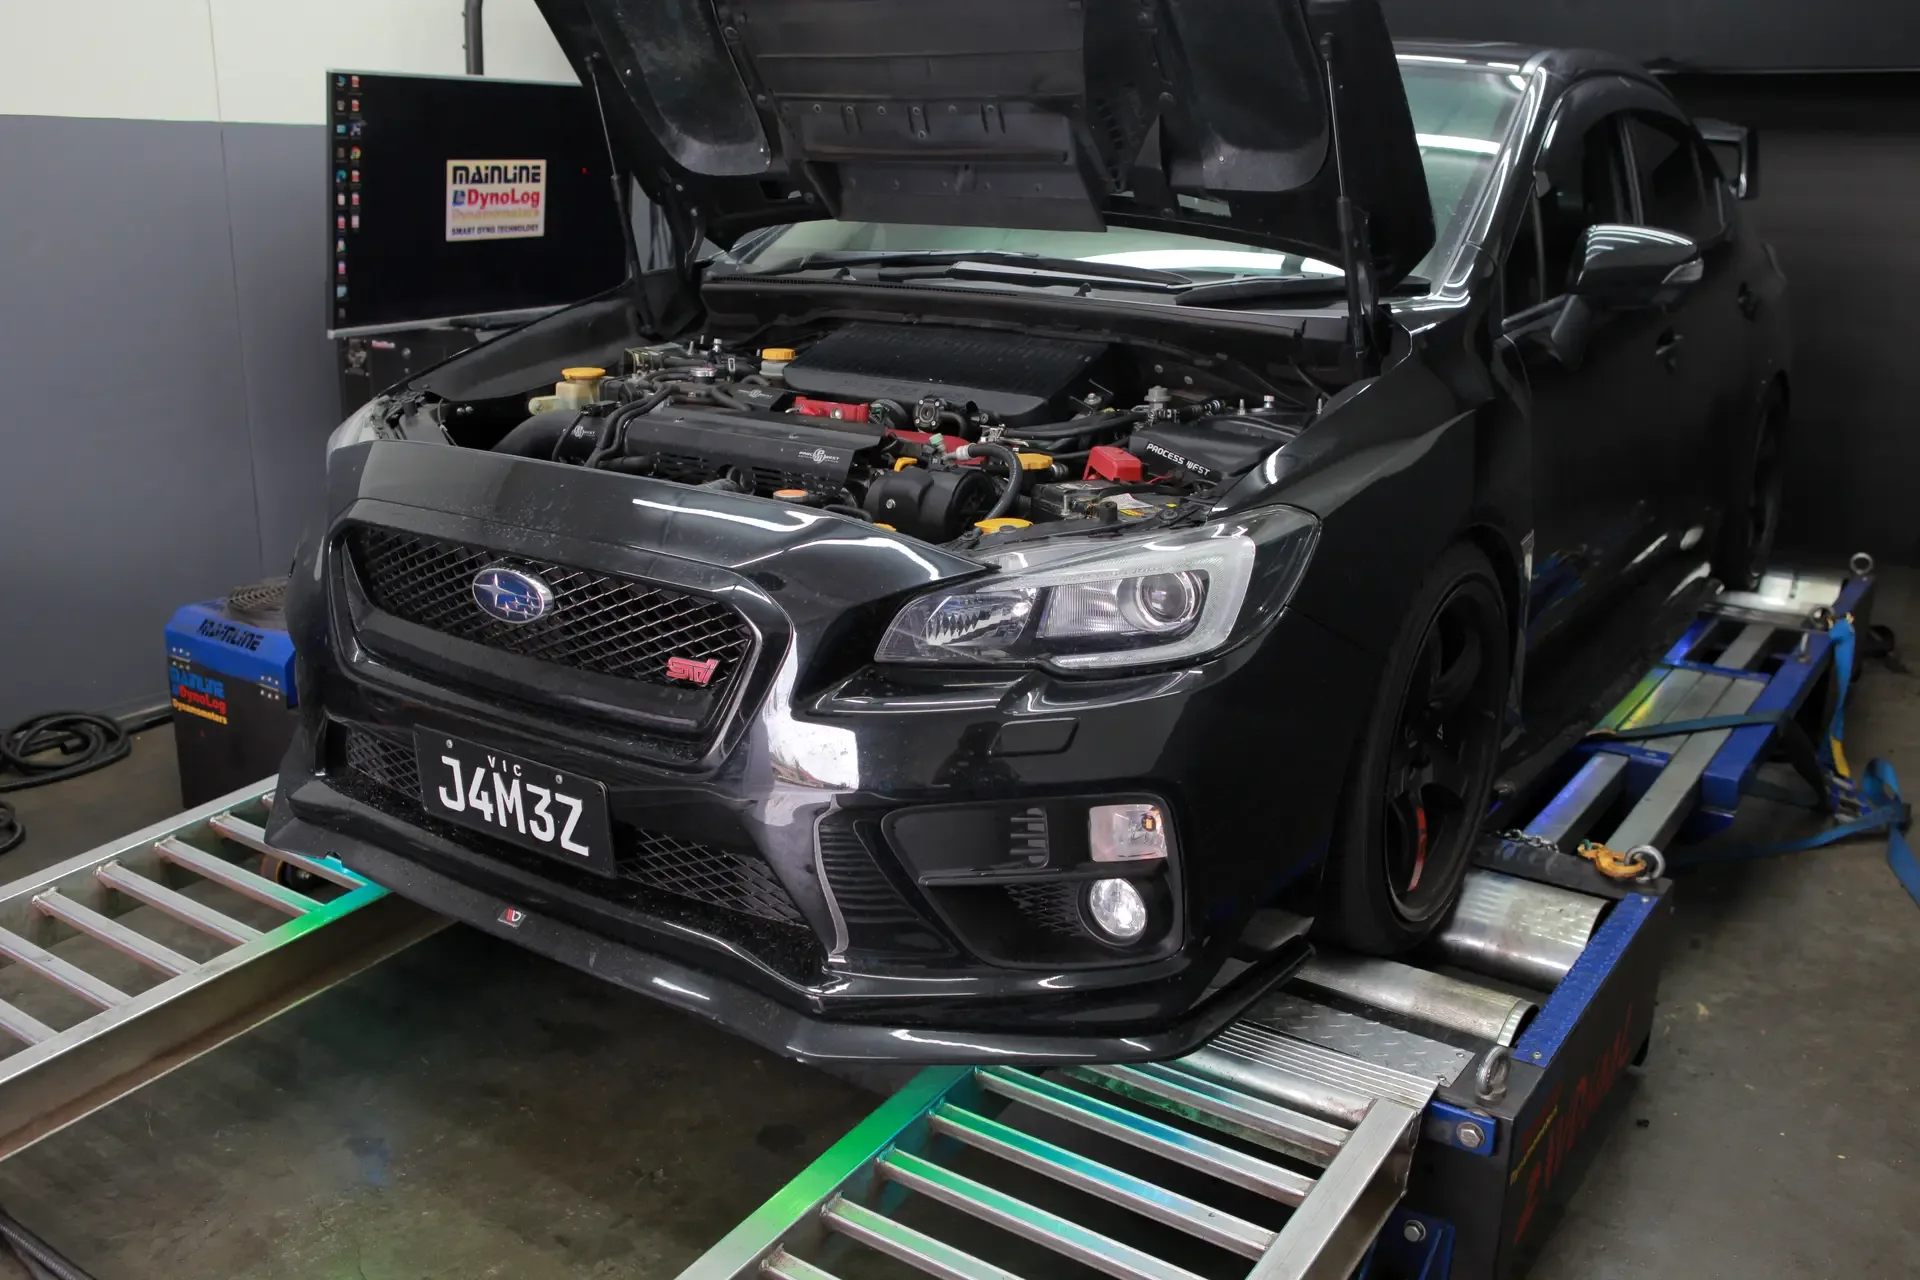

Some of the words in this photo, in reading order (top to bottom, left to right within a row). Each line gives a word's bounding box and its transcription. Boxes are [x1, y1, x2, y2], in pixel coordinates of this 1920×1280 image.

[467, 188, 540, 210] DynoLog
[452, 227, 475, 236] SMART
[477, 226, 495, 234] DYNO
[497, 224, 539, 234] TECHNOLOGY
[1146, 443, 1185, 465] PROCESS
[1186, 460, 1211, 476] WEST
[171, 697, 228, 725] Dynamometers
[179, 685, 227, 715] DynoLog
[487, 755, 522, 777] VIC
[438, 755, 590, 857] J4M3Z
